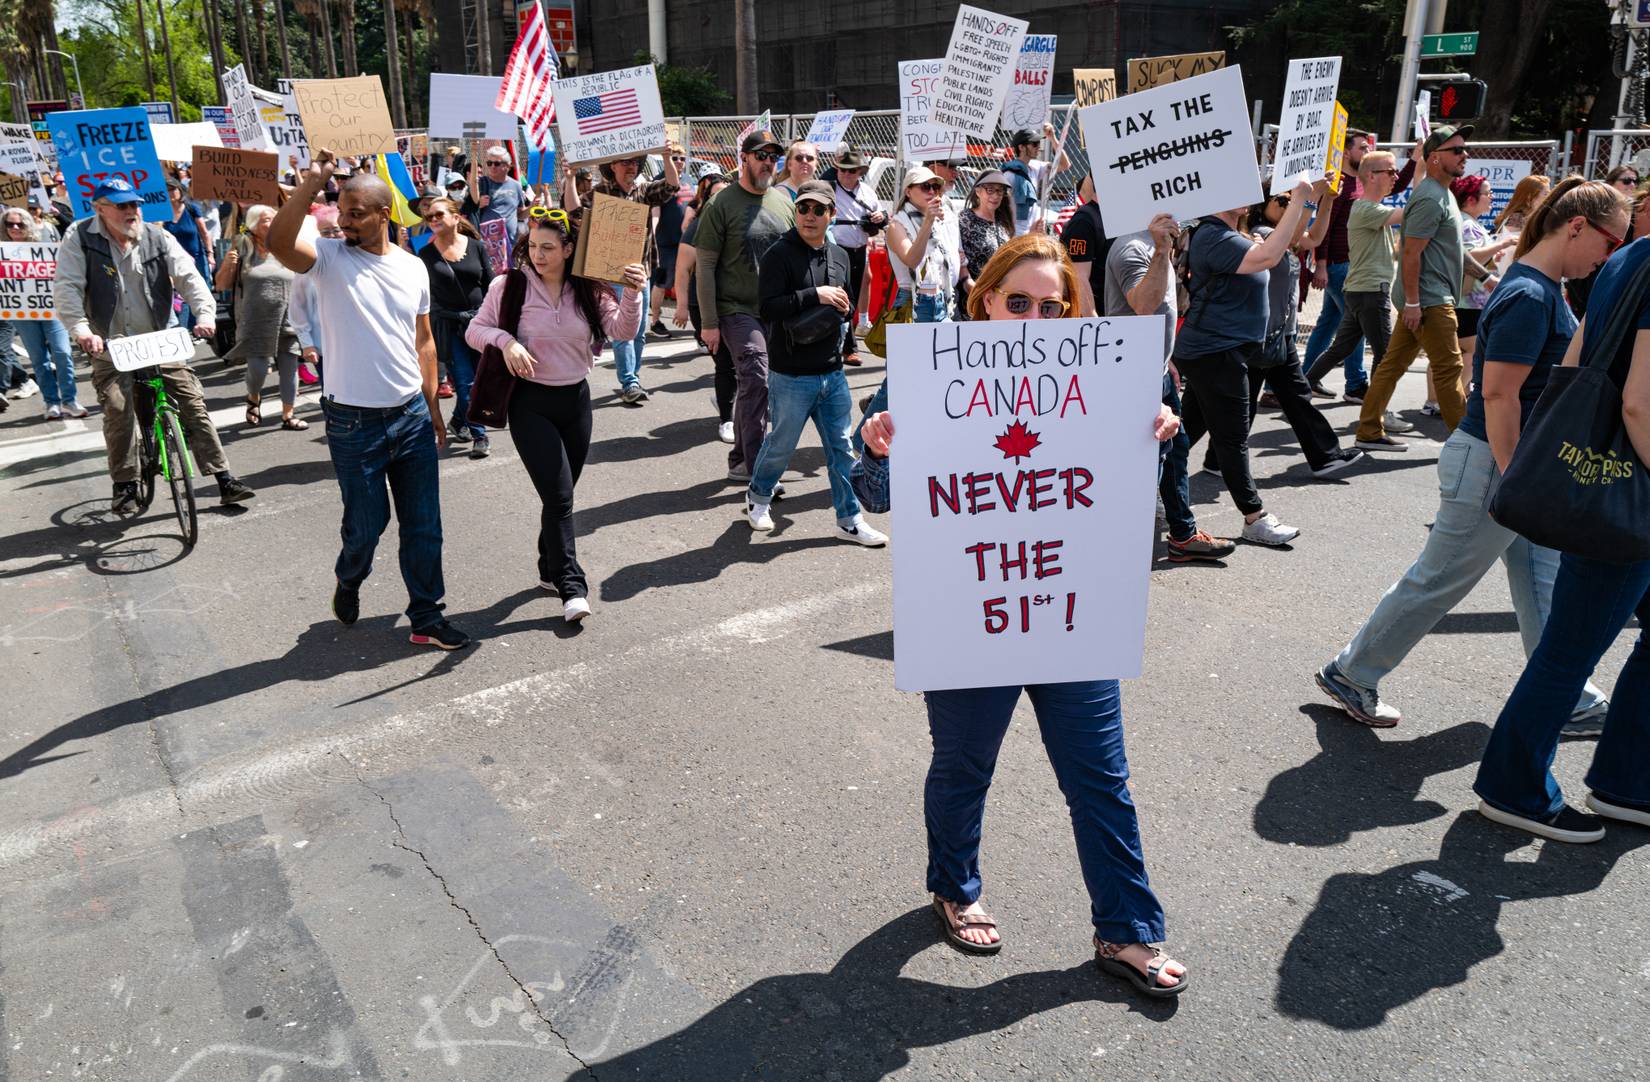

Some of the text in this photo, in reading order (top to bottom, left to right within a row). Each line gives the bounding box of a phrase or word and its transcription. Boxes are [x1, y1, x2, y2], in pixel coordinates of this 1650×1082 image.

[961, 11, 1019, 38] HANDS OFF
[963, 31, 1011, 53] FREE SPEECH
[1437, 37, 1444, 52] L
[952, 53, 1002, 75] IMMIGRANTS
[982, 50, 1008, 65] RIGHTS
[556, 79, 578, 91] THIS
[582, 77, 589, 86] IS
[591, 74, 604, 84] THE
[608, 71, 632, 82] FLAG
[646, 67, 652, 76] A
[948, 64, 993, 84] PALESTINE
[1014, 69, 1048, 86] BALLS
[1301, 61, 1335, 80] THE ENEMY
[581, 81, 620, 97] REPUBLIC
[943, 76, 993, 98] PUBLIC LANDS
[1075, 78, 1115, 108] COMPOST
[1289, 85, 1334, 109] DOESN'T ARRIVE
[297, 83, 381, 114] Protect
[935, 98, 985, 120] EDUCATION
[944, 89, 994, 111] CIVIL RIGHTS
[934, 111, 984, 134] HEALTHCARE
[1111, 94, 1213, 139] TAX THE
[1296, 113, 1306, 131] BY
[1, 126, 32, 139] WAKE
[77, 121, 149, 148] FREEZE
[562, 143, 571, 153] IF
[573, 140, 587, 150] YOU
[588, 136, 607, 146] WANT
[610, 133, 616, 142] A
[905, 131, 965, 150] TOO LATE
[576, 136, 660, 160] GET YOUR OWN FLAG
[1117, 129, 1226, 174] PENGUINS
[1282, 132, 1327, 157] HE ARRIVES BY
[80, 145, 137, 171] ICE
[200, 150, 242, 165] BUILD
[212, 165, 277, 182] KINDNESS
[225, 178, 247, 189] NOT
[1480, 167, 1515, 181] DPR
[213, 187, 264, 201] WALLS
[1151, 171, 1202, 201] RICH
[30, 247, 58, 262] MY
[112, 329, 188, 366] PROTEST
[932, 320, 1125, 370] Hands off:
[944, 374, 1088, 419] CANADA
[927, 467, 1095, 518] NEVER
[964, 539, 1064, 582] THE
